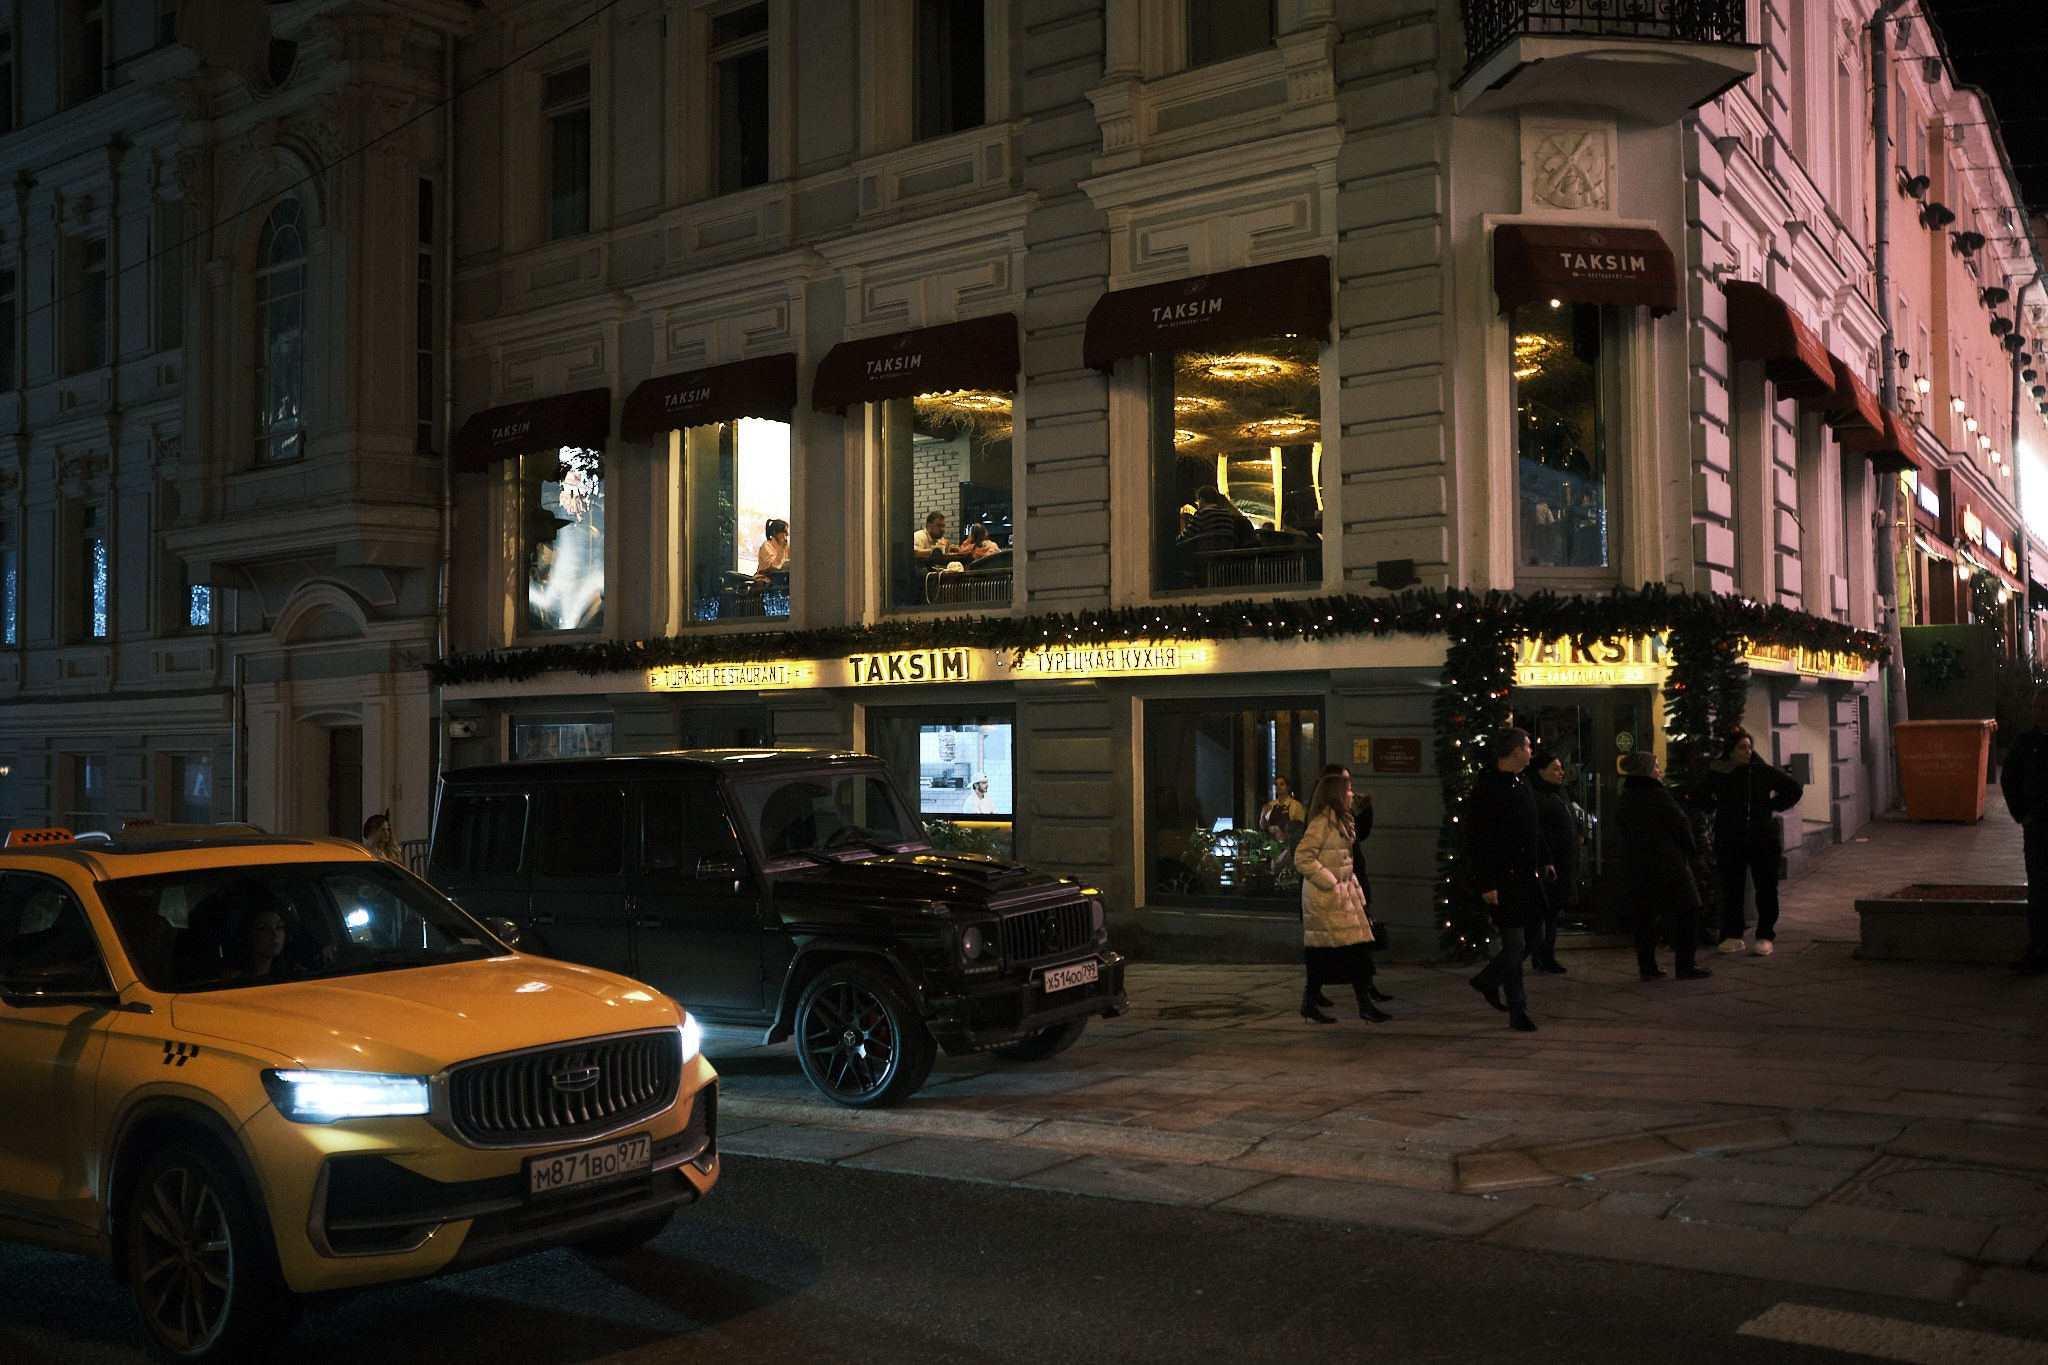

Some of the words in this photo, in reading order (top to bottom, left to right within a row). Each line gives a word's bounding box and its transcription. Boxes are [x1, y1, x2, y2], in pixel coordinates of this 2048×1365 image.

[1560, 253, 1646, 272] TAKSIM
[1152, 297, 1223, 322] TAKSIM
[866, 354, 922, 374] TAKSIM
[664, 387, 711, 407] TAKSIM
[490, 421, 531, 440] TAKSIM
[849, 651, 965, 683] TAKSIM
[1036, 649, 1115, 673] ТУРЕЦКАЯ
[1121, 647, 1175, 669] КУХНЯ
[664, 667, 710, 687] TURKISH
[713, 665, 785, 686] RESTAURANT
[536, 1153, 616, 1190] М871ВО
[619, 1139, 646, 1163] 977
